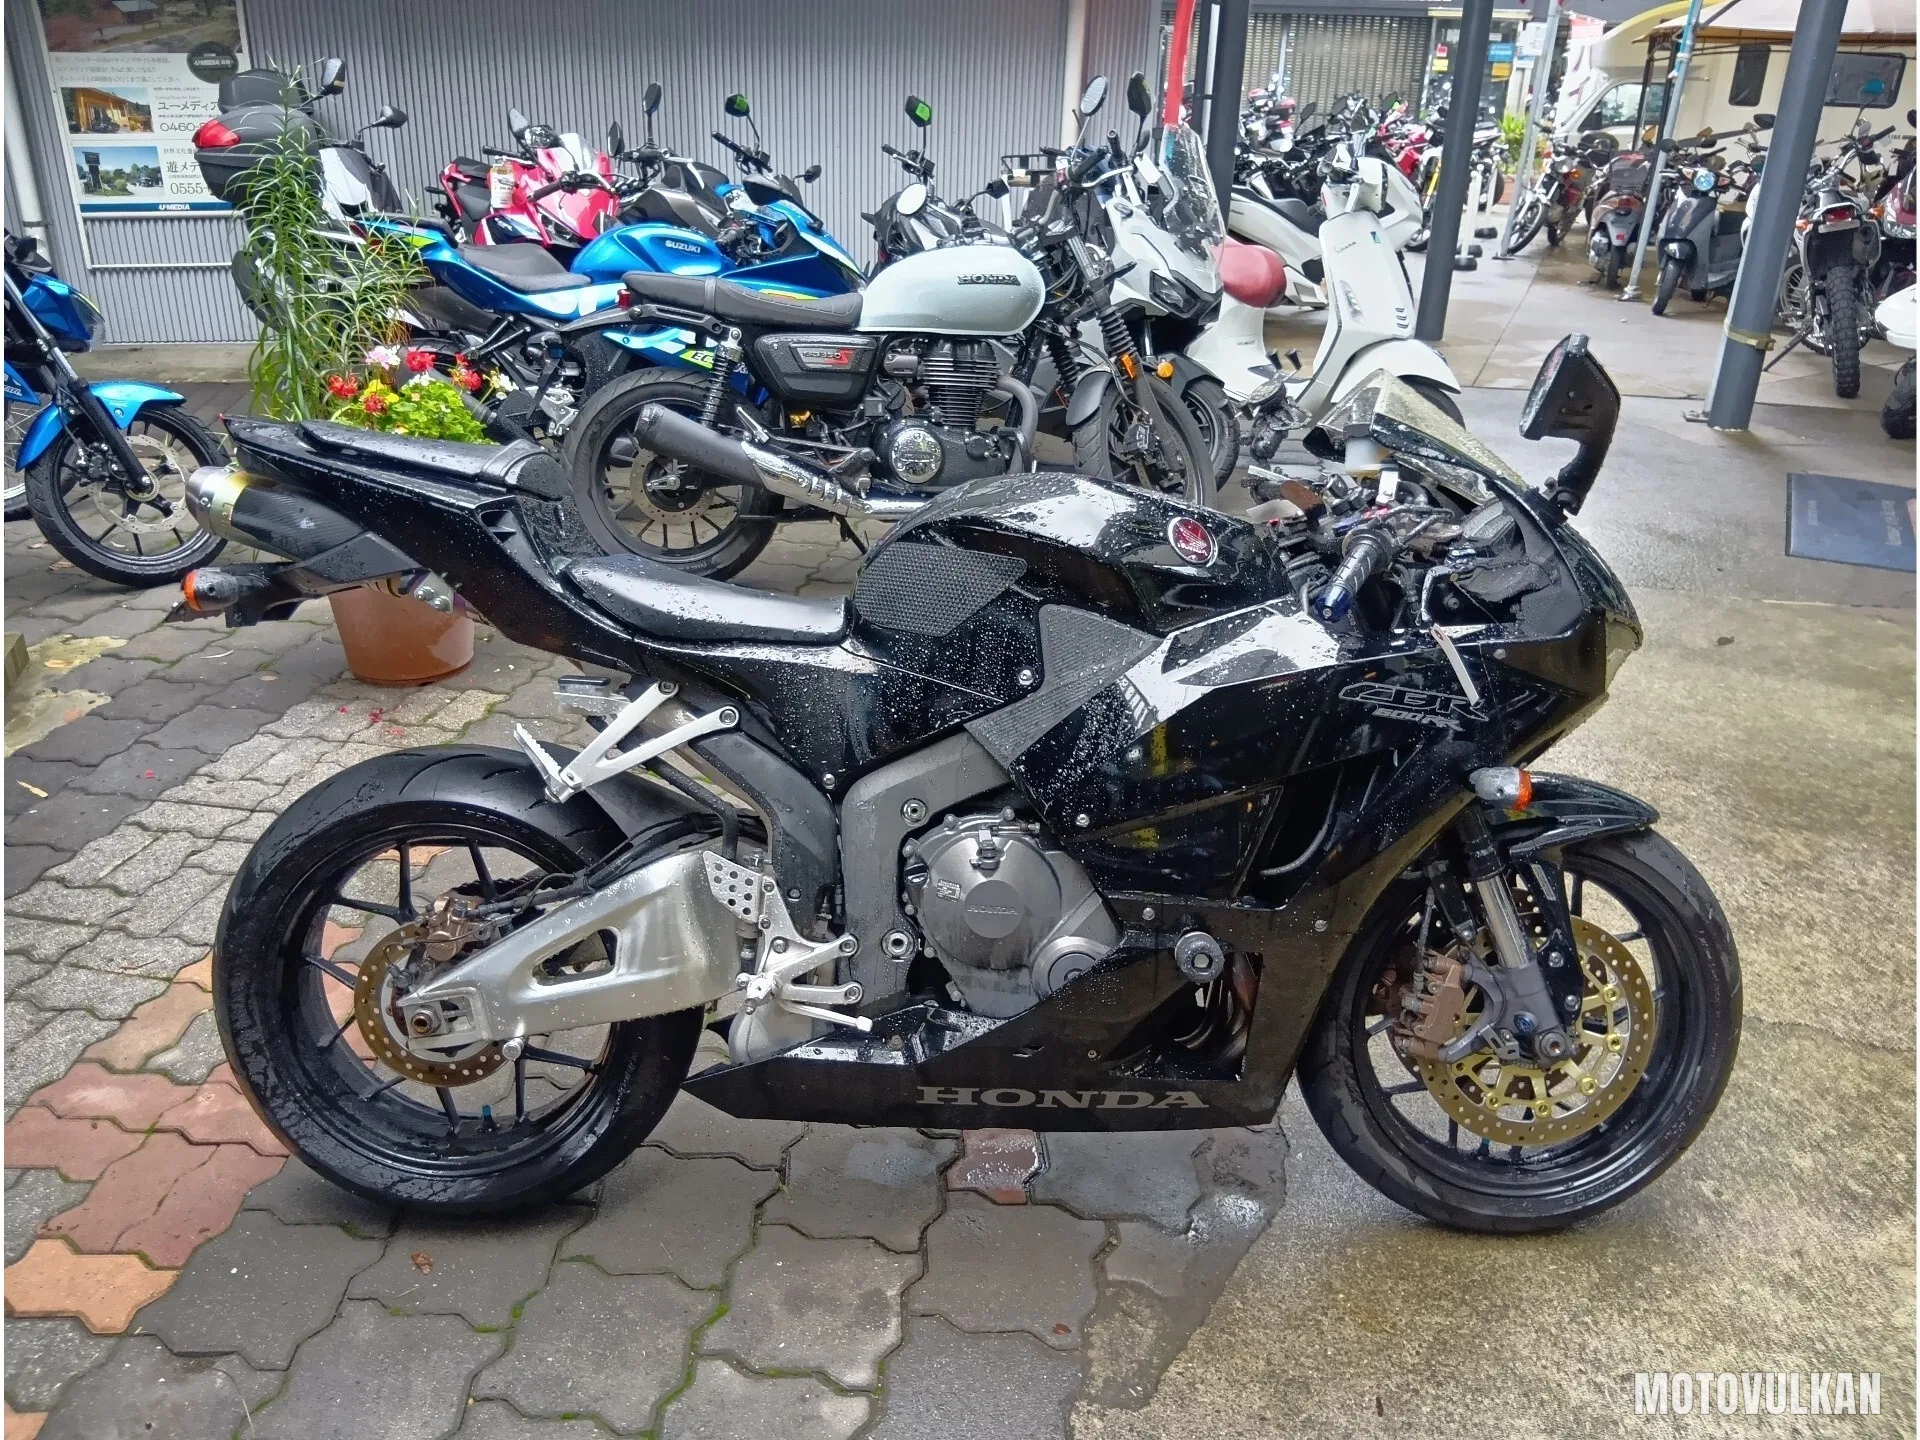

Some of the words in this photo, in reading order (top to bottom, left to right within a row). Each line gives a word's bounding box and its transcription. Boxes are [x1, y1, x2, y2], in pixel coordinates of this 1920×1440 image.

[665, 239, 701, 254] SUZUKI
[957, 273, 1021, 287] HONDA
[915, 1085, 1210, 1109] HONDA
